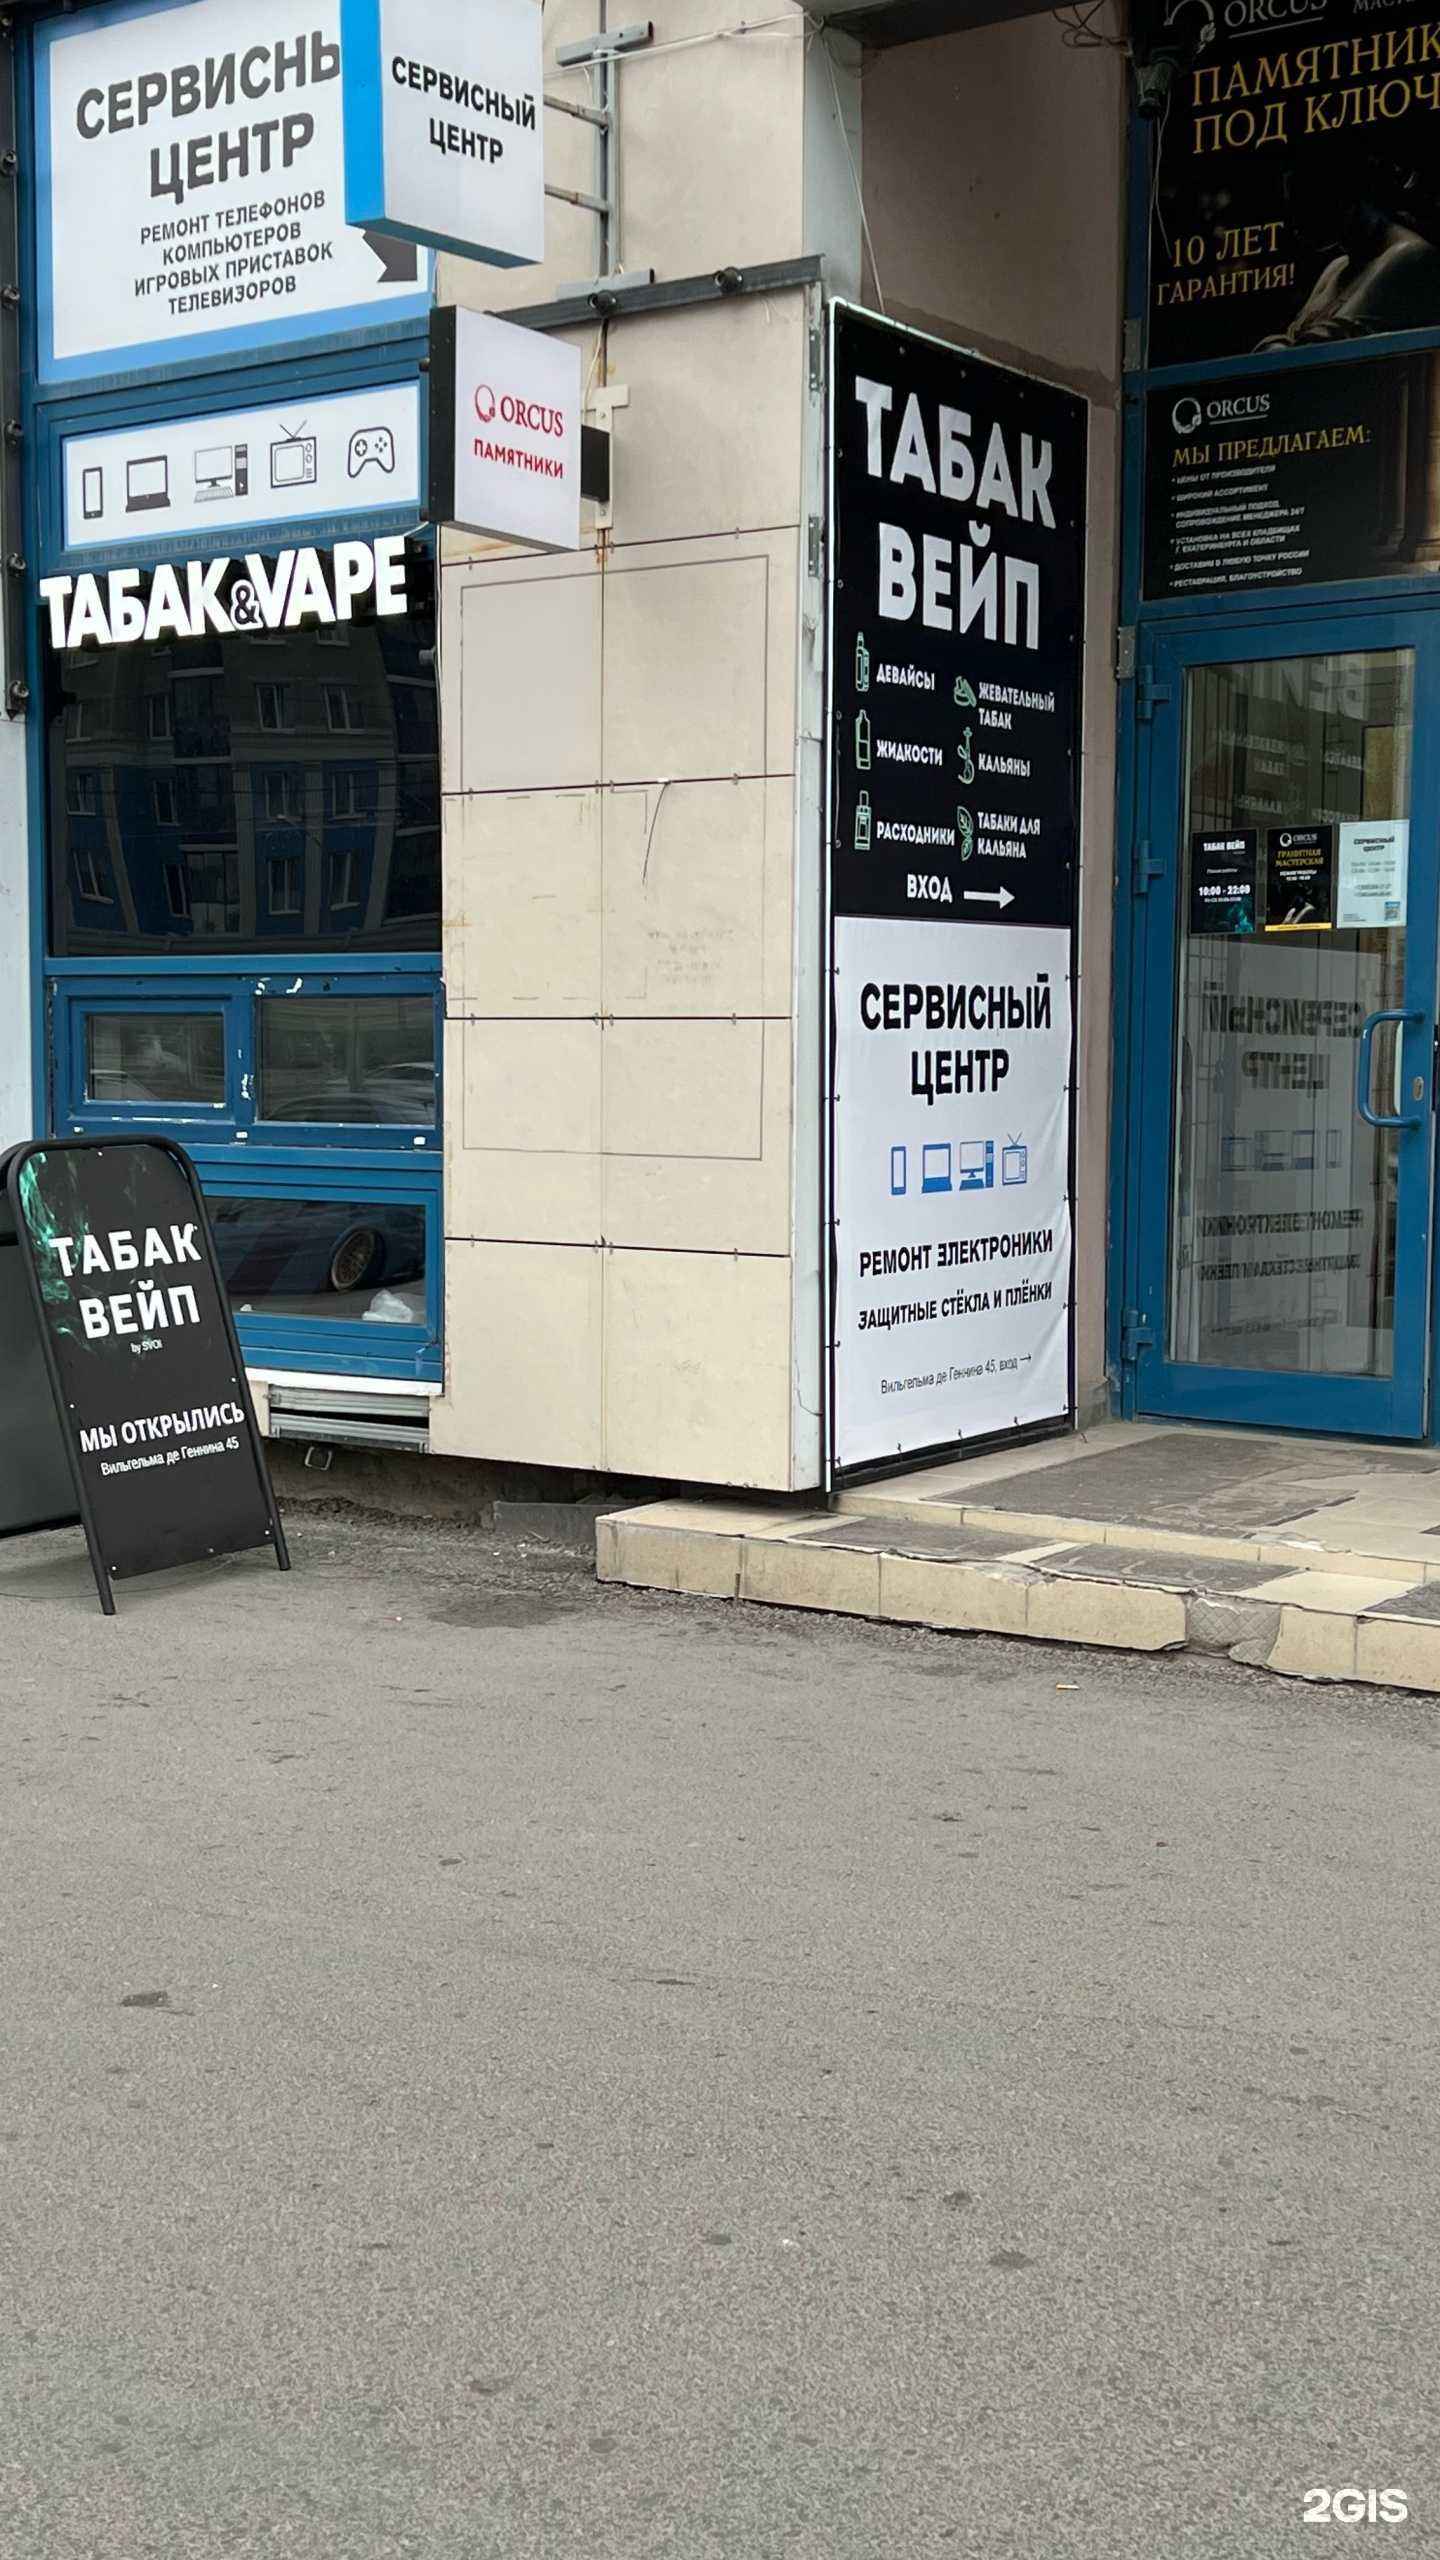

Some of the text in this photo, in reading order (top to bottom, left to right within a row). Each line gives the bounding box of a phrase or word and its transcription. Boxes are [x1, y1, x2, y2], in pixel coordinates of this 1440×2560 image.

[391, 55, 537, 131] СЕРВИСНЫЙ
[429, 117, 504, 165] ЦЕНТР
[1193, 102, 1288, 154] ПОД
[150, 112, 315, 204] ЦЕНТР
[139, 190, 326, 245] РЕМОНТ ТЕЛЕФОНОВ
[162, 221, 302, 266] КОМПЬЮТЕРОВ
[1174, 221, 1285, 268] 10 ЛЕТ
[134, 241, 334, 297] ИГРОВЫХ ПРИСТАВОК
[1157, 262, 1296, 306] ГАРАНТИЯ!
[167, 275, 297, 316] ТЕЛЕВИЗОРОВ
[499, 394, 564, 437] ORCUS
[1206, 393, 1271, 419] ORCUS
[473, 438, 564, 480] ПАМЯТНИКИ
[855, 374, 1057, 529] ТАБАК
[1172, 424, 1372, 468] МЫ ПРЕДЛАГАЕМ:
[1200, 473, 1210, 482] ОТ
[1214, 483, 1269, 498] АССОРТИМЕНТ
[1220, 531, 1230, 540] НА
[1243, 538, 1249, 546] И
[878, 519, 1040, 650] ВЕЙП
[876, 663, 935, 691] ДЕВАЙСЫ
[978, 681, 1055, 712] ЖЕВАТЕЛЬНЫЙ
[978, 707, 1013, 730] ТАБАК
[876, 739, 944, 766] ЖИДКОСТИ
[978, 753, 1031, 777] КАЛЬЯНЫ
[876, 821, 956, 847] РАСХОДНИКИ
[977, 811, 1041, 836] ТАБАКИ ДЛЯ
[977, 840, 1027, 859] КАЛЬЯНА
[906, 873, 953, 903] ВХОД
[1198, 885, 1221, 896] 10:00
[860, 972, 1051, 1030] СЕРВИСНЫЙ
[911, 1048, 1010, 1106] ЦЕНТР
[49, 1222, 202, 1278] ТАБАК
[859, 1228, 1053, 1278] РЕМОНТ ЭЛЕКТРОНИКИ
[79, 1278, 200, 1340] ВЕЙП
[858, 1279, 1052, 1331] ЗАЩИТНЫЕ СТЁКЛА И ПЛЁНКИ
[130, 1342, 141, 1354] by
[881, 1374, 935, 1394] Вильгельма
[936, 1370, 948, 1386] де
[949, 1364, 984, 1382] Геннина
[999, 1356, 1018, 1371] вход
[80, 1402, 245, 1453] МЫ ОТКРЫЛИСЬ
[100, 1436, 240, 1476] Вильгельма де Геннина 45
